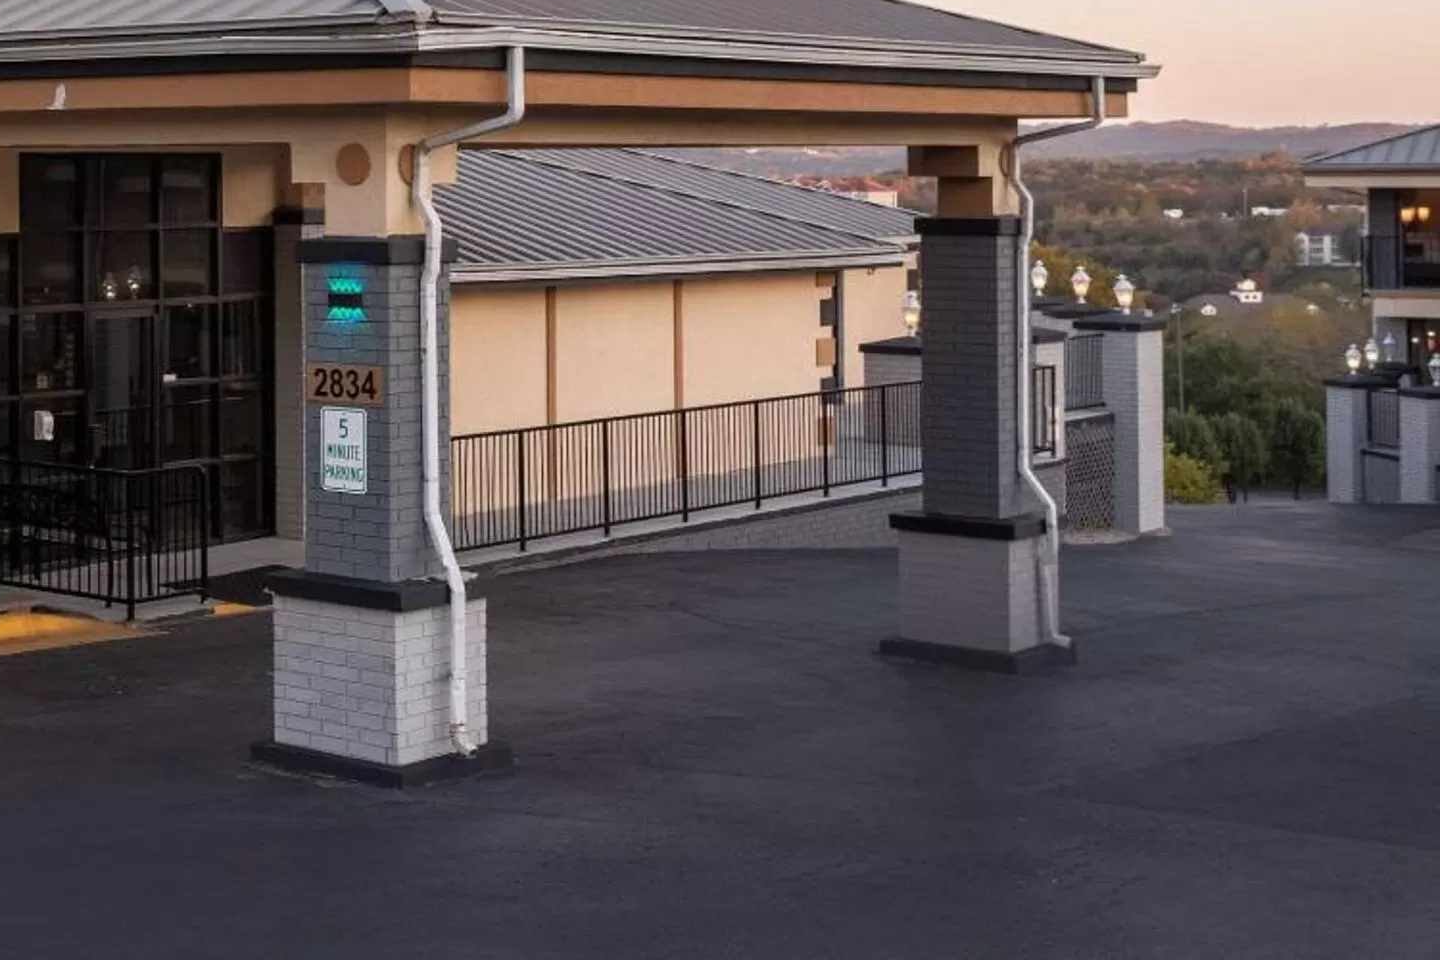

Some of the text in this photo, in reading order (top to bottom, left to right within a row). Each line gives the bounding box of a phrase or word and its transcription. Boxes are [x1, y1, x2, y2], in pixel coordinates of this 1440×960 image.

[314, 368, 377, 400] 2834
[338, 418, 349, 439] 5
[327, 443, 361, 460] MINUTE
[325, 464, 363, 482] PARKING
